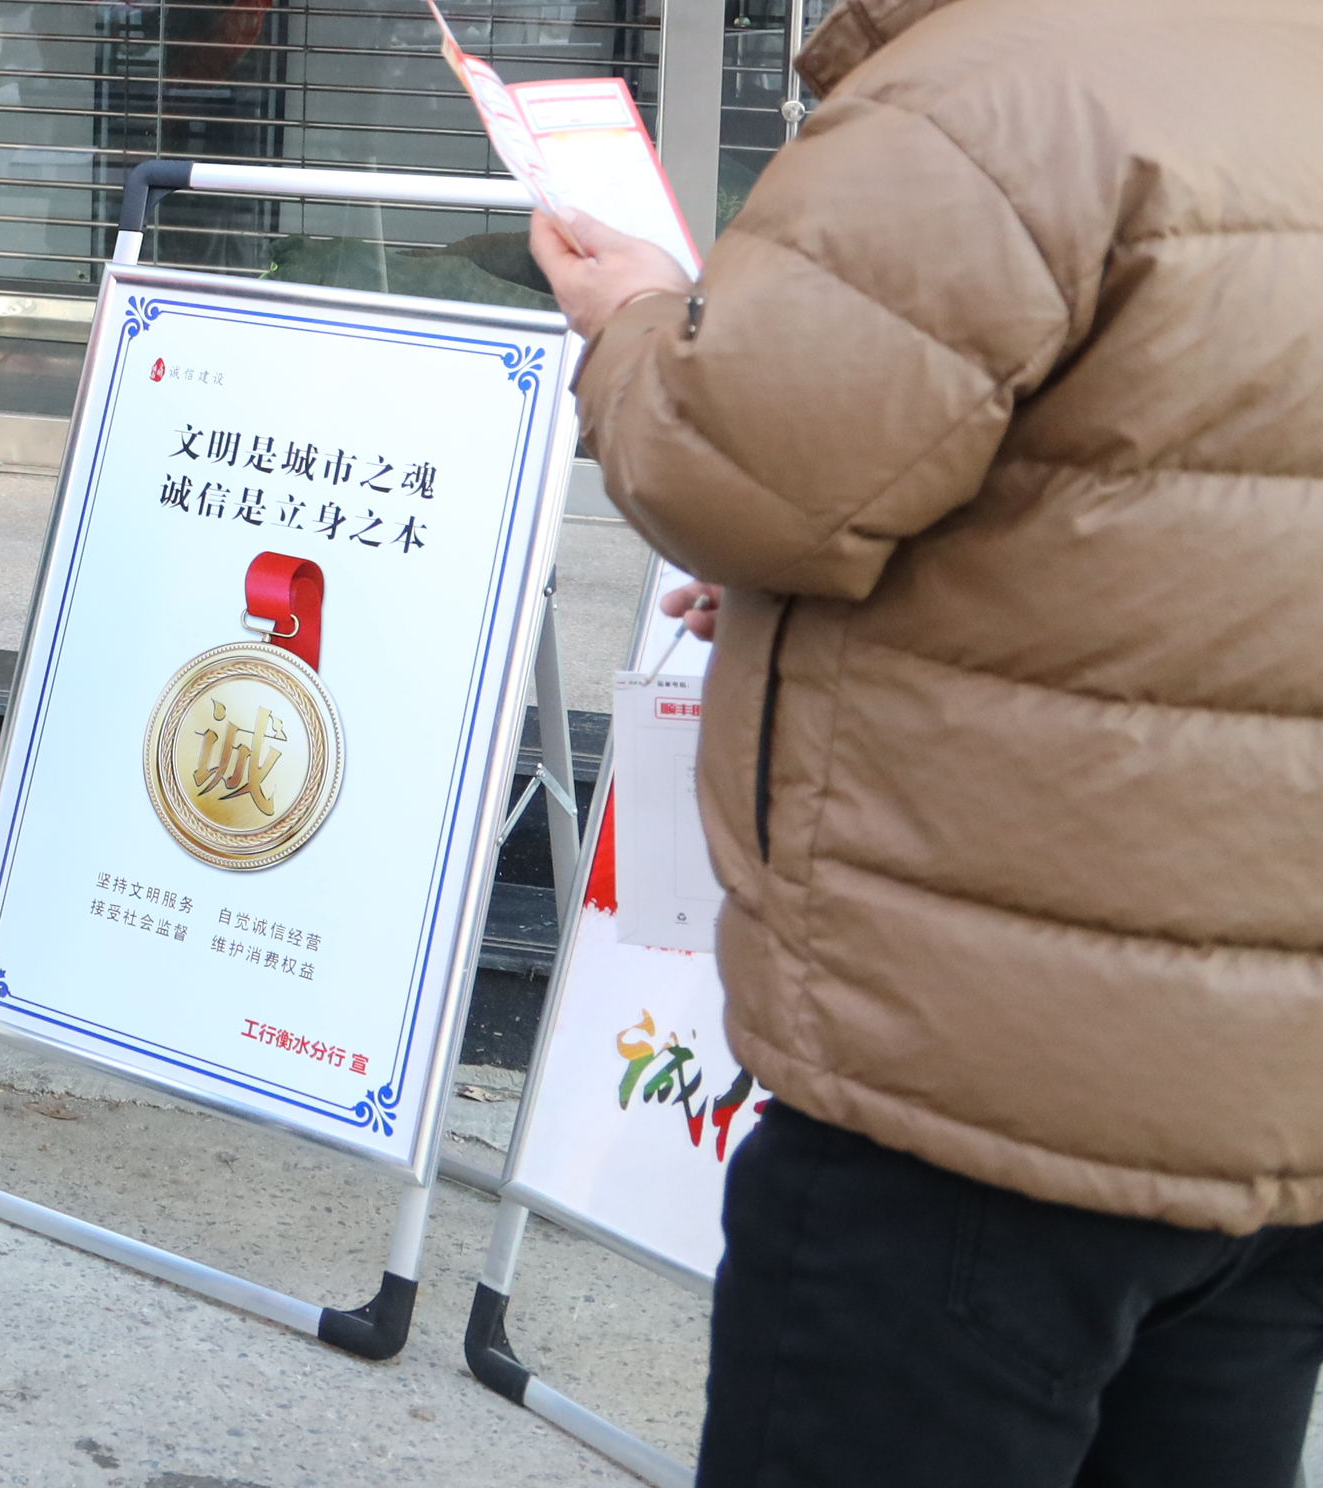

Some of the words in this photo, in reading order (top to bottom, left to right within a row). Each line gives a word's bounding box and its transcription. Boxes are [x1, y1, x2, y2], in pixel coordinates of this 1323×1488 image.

[169, 365, 225, 386] 诚信建设
[168, 423, 438, 500] 文明是城市之魂
[159, 473, 429, 554] 诚信是立身之本
[192, 698, 289, 817] 诚
[89, 898, 189, 942] 接受社会监督
[210, 934, 316, 981] 维护消费权益
[95, 871, 195, 914] 坚持文明服务
[218, 907, 323, 953] 自觉诚信经营
[241, 1018, 347, 1068] 工行衡水分行
[349, 1053, 369, 1076] 宣
